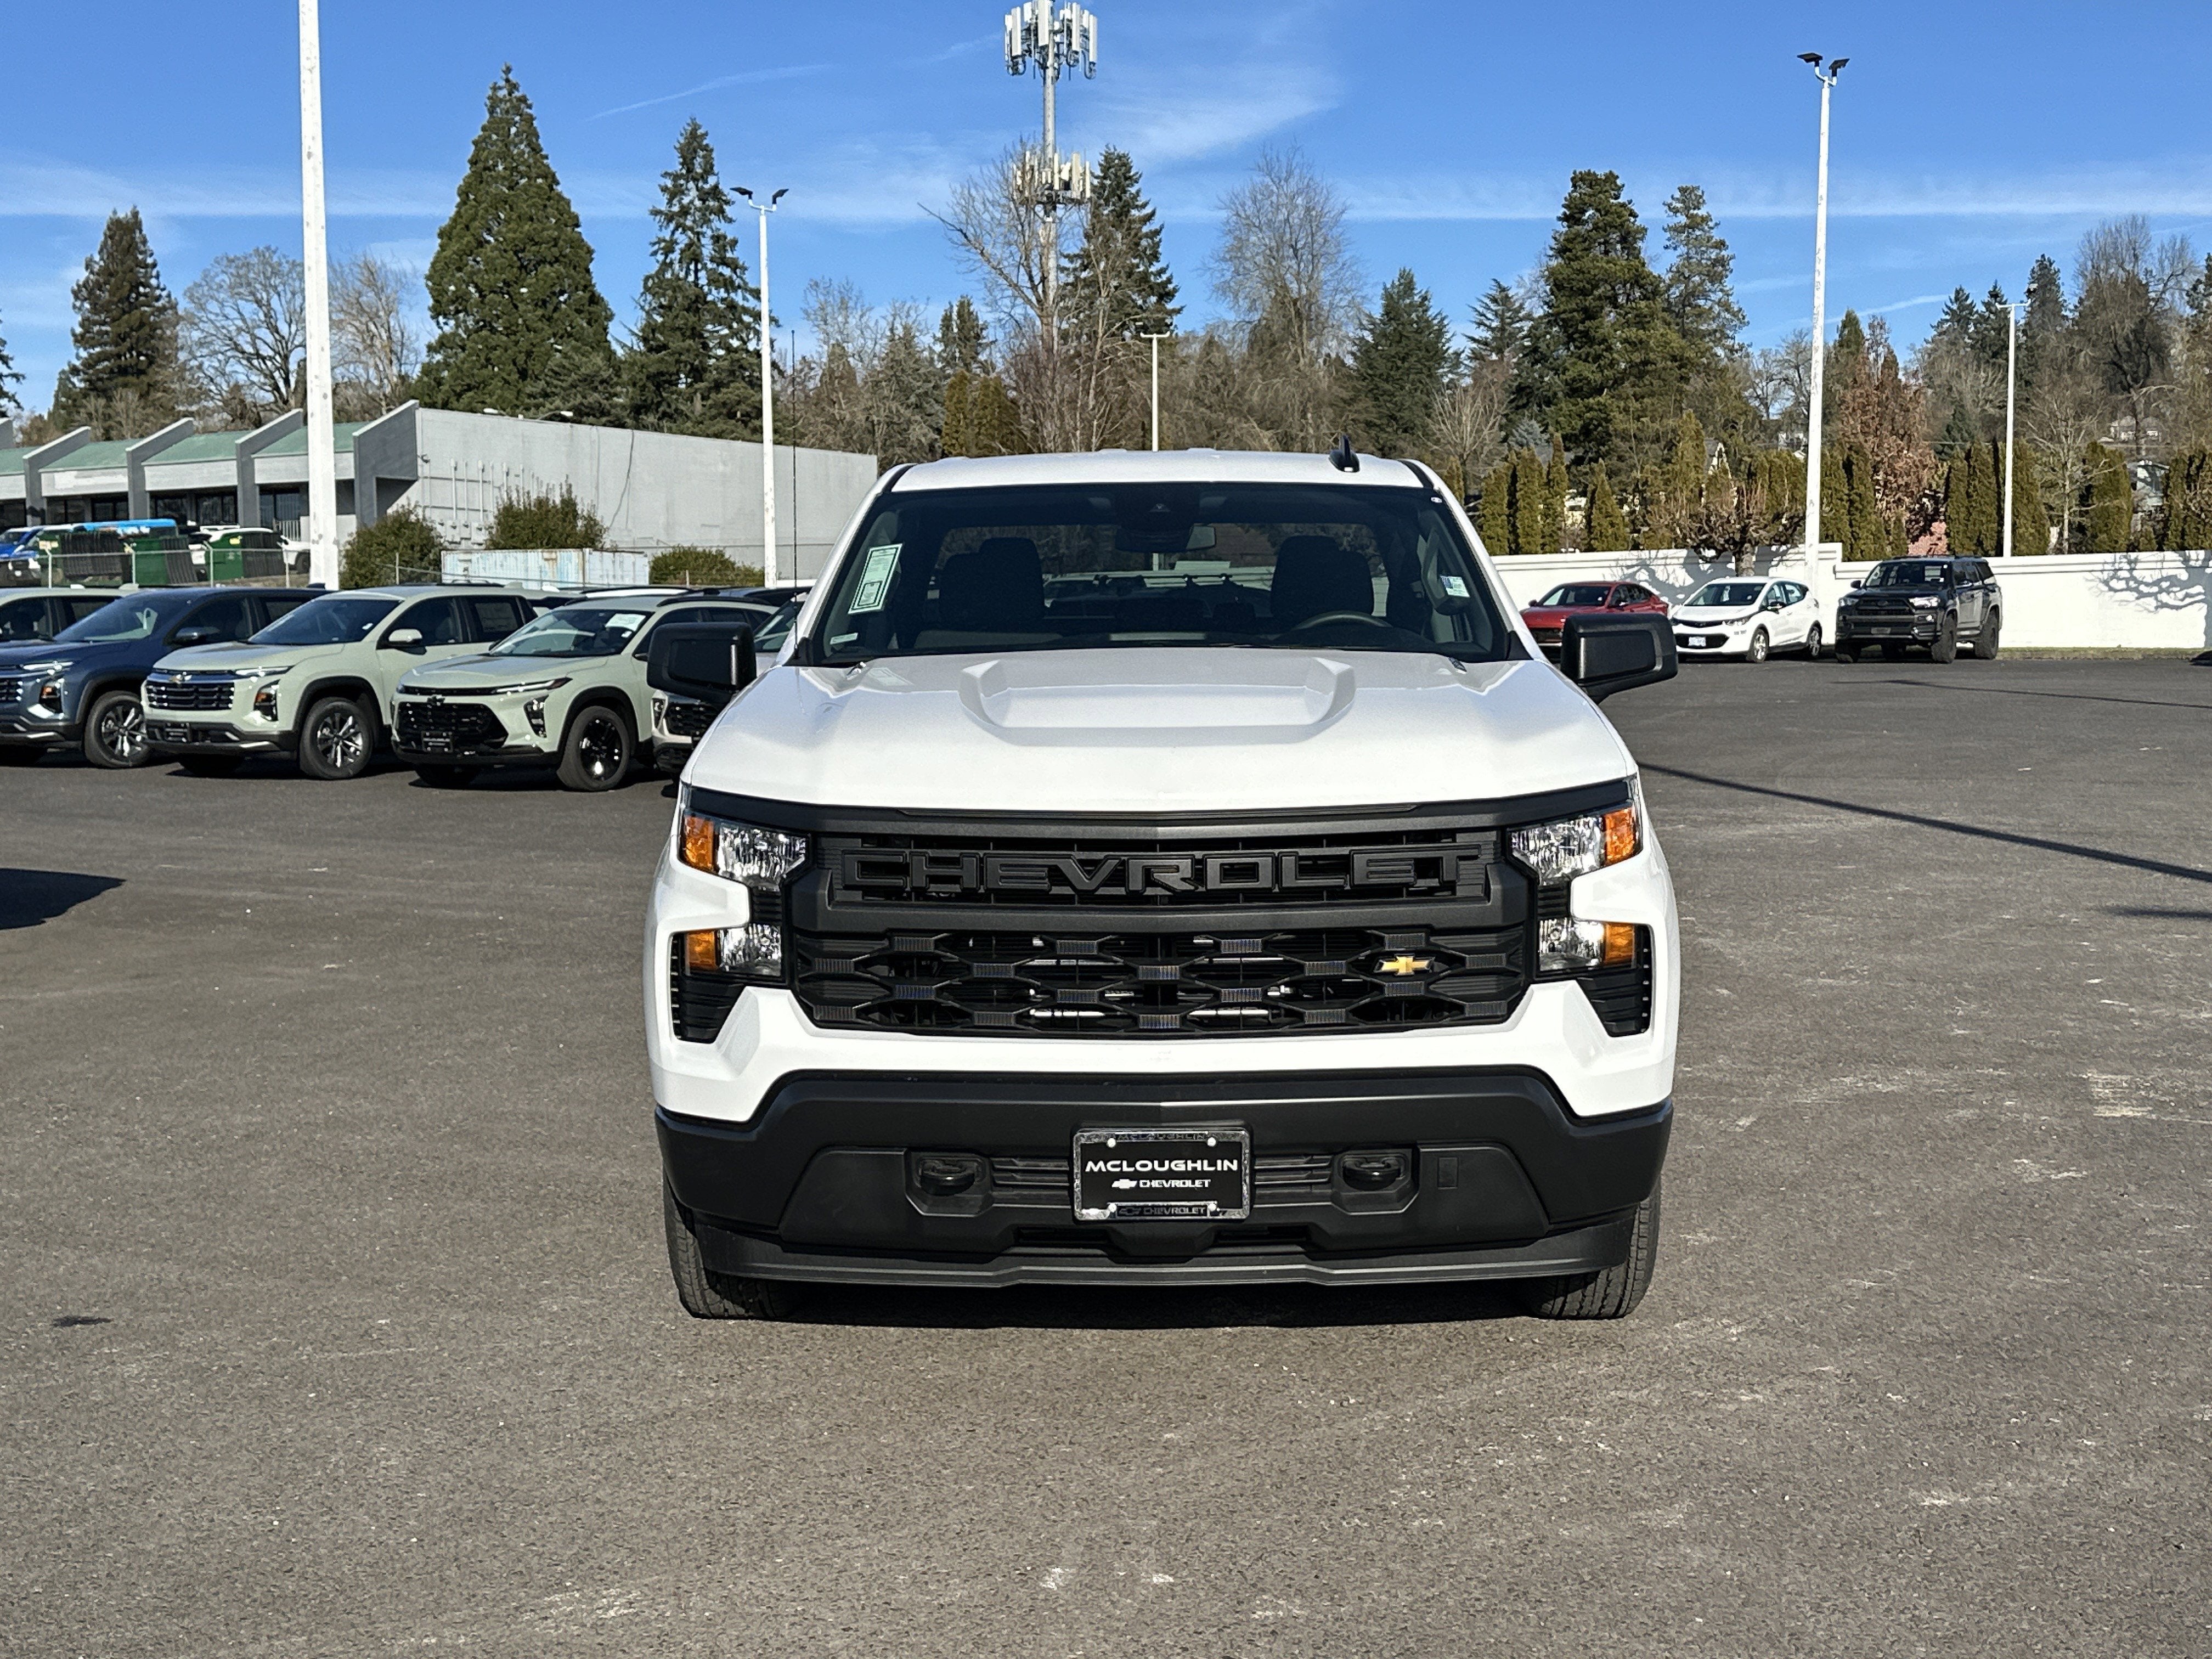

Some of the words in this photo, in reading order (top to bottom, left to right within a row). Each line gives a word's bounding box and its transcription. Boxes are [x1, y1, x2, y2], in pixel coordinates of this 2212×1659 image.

[842, 844, 1480, 894] CHEVROLET
[1085, 1160, 1238, 1172] MCLOUGHLIN
[1139, 1180, 1211, 1188] CHEVROLET
